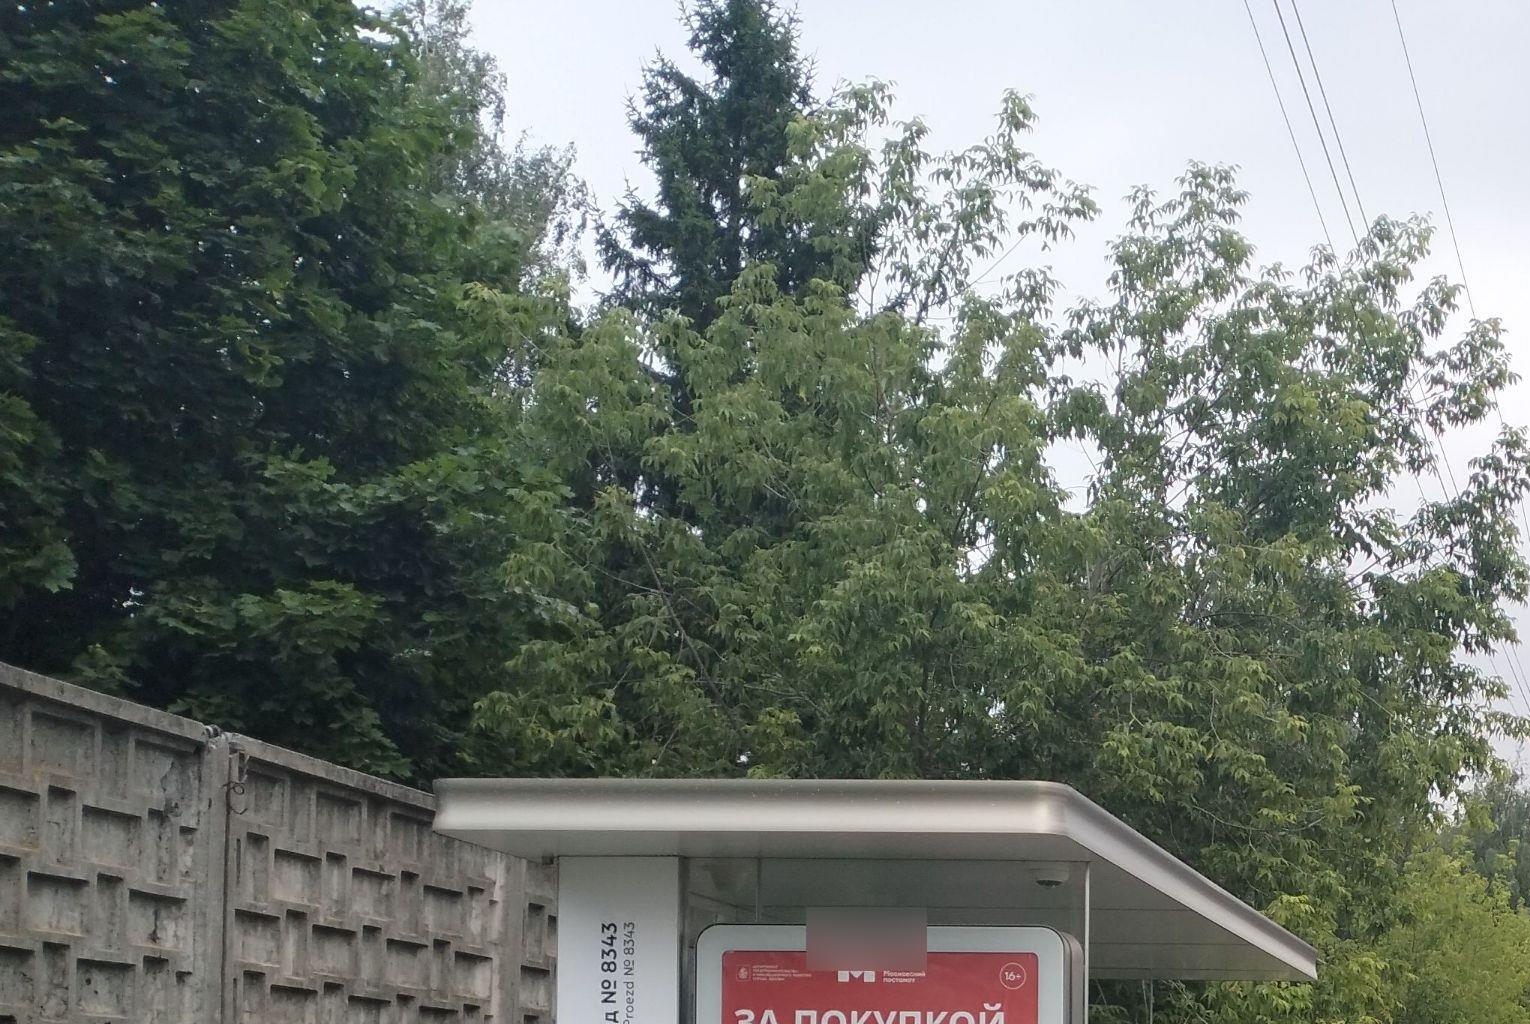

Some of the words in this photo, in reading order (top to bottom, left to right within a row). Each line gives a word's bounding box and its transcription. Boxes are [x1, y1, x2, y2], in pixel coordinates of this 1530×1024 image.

[601, 922, 617, 973] 8343
[623, 921, 635, 956] 8343
[1005, 972, 1022, 982] 16+
